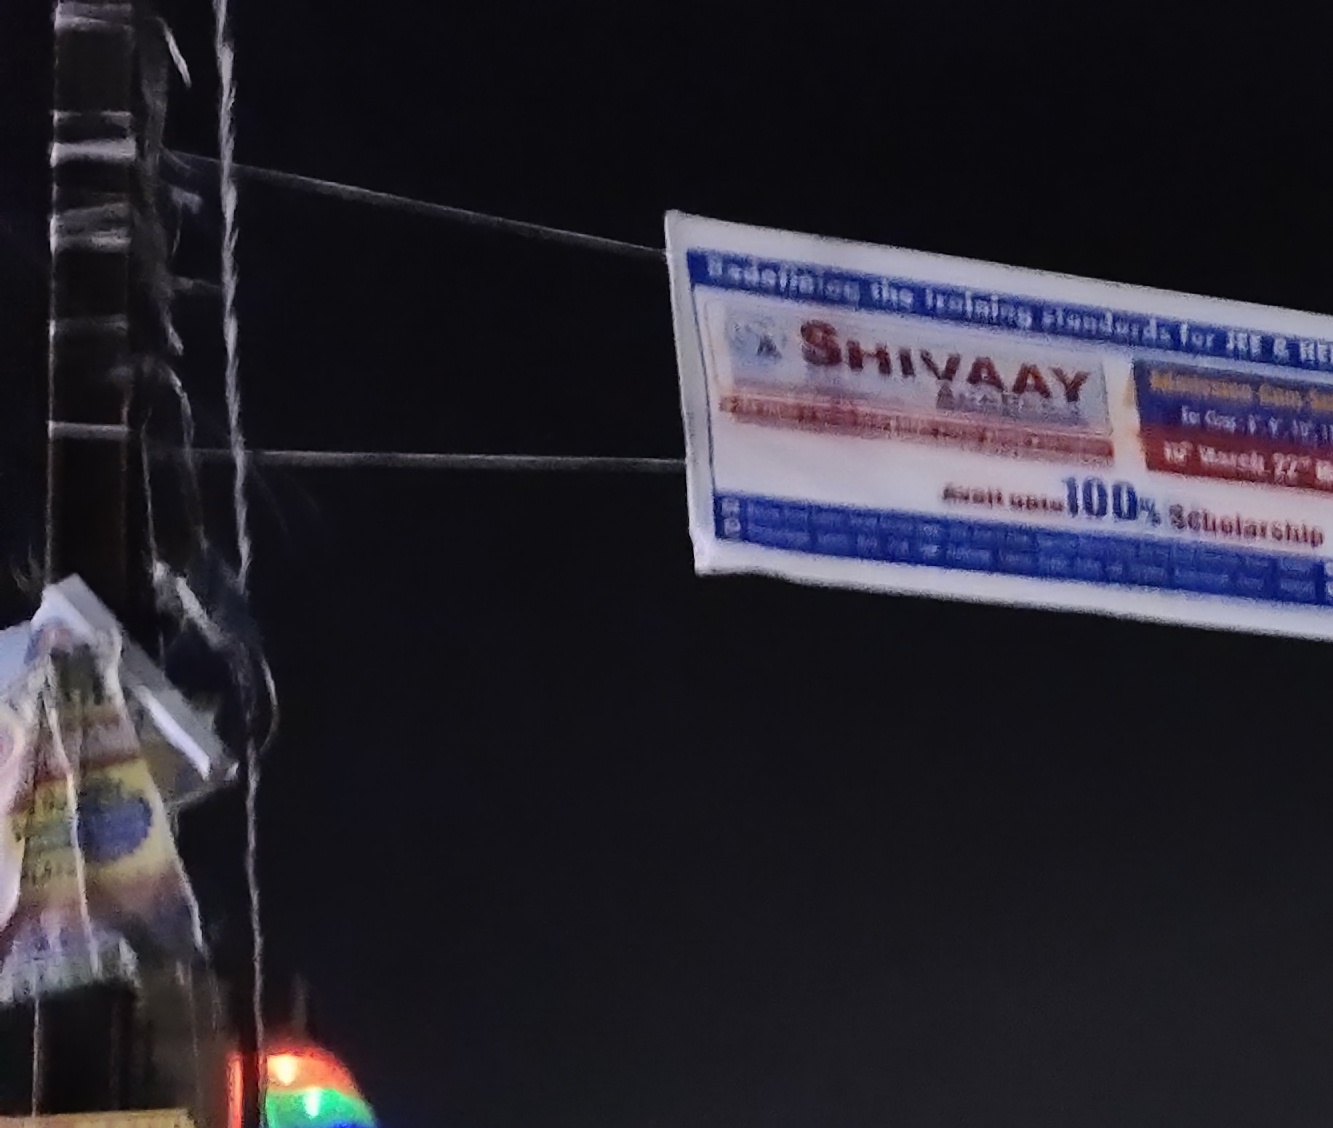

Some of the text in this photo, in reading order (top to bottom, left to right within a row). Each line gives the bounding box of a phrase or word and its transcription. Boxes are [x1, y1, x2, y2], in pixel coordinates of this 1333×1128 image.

[708, 256, 861, 306] Redefining
[870, 278, 915, 307] the
[924, 289, 1033, 331] training
[1042, 306, 1171, 343] standards
[1179, 320, 1215, 349] for
[1168, 503, 1325, 549] Scholarship
